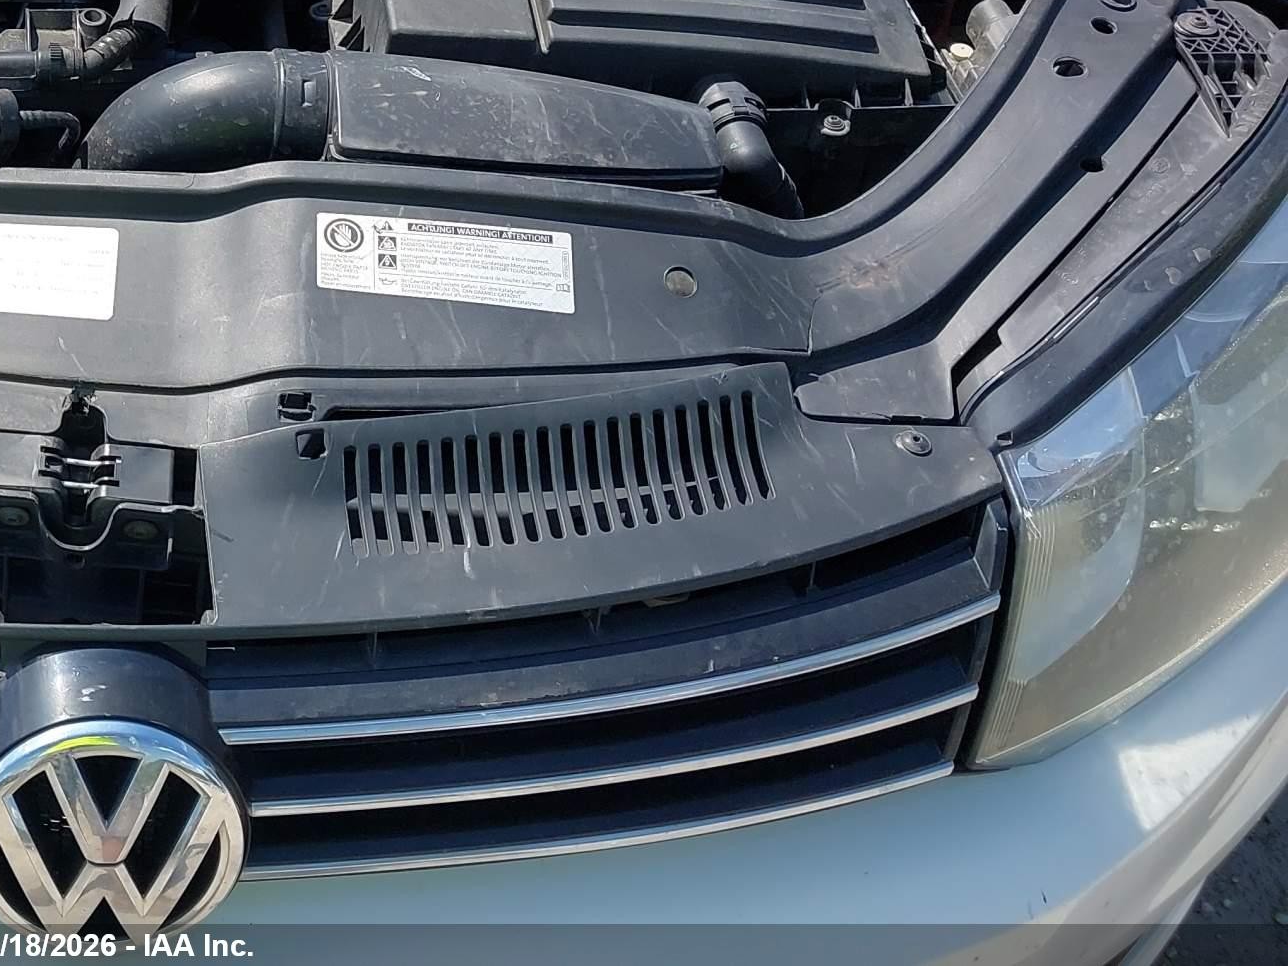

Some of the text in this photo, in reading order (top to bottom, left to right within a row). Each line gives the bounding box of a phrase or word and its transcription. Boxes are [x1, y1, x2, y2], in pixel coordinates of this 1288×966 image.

[410, 223, 455, 234] ACHTUNG!
[456, 227, 500, 239] WARNING!
[501, 231, 551, 243] ATTENTION!
